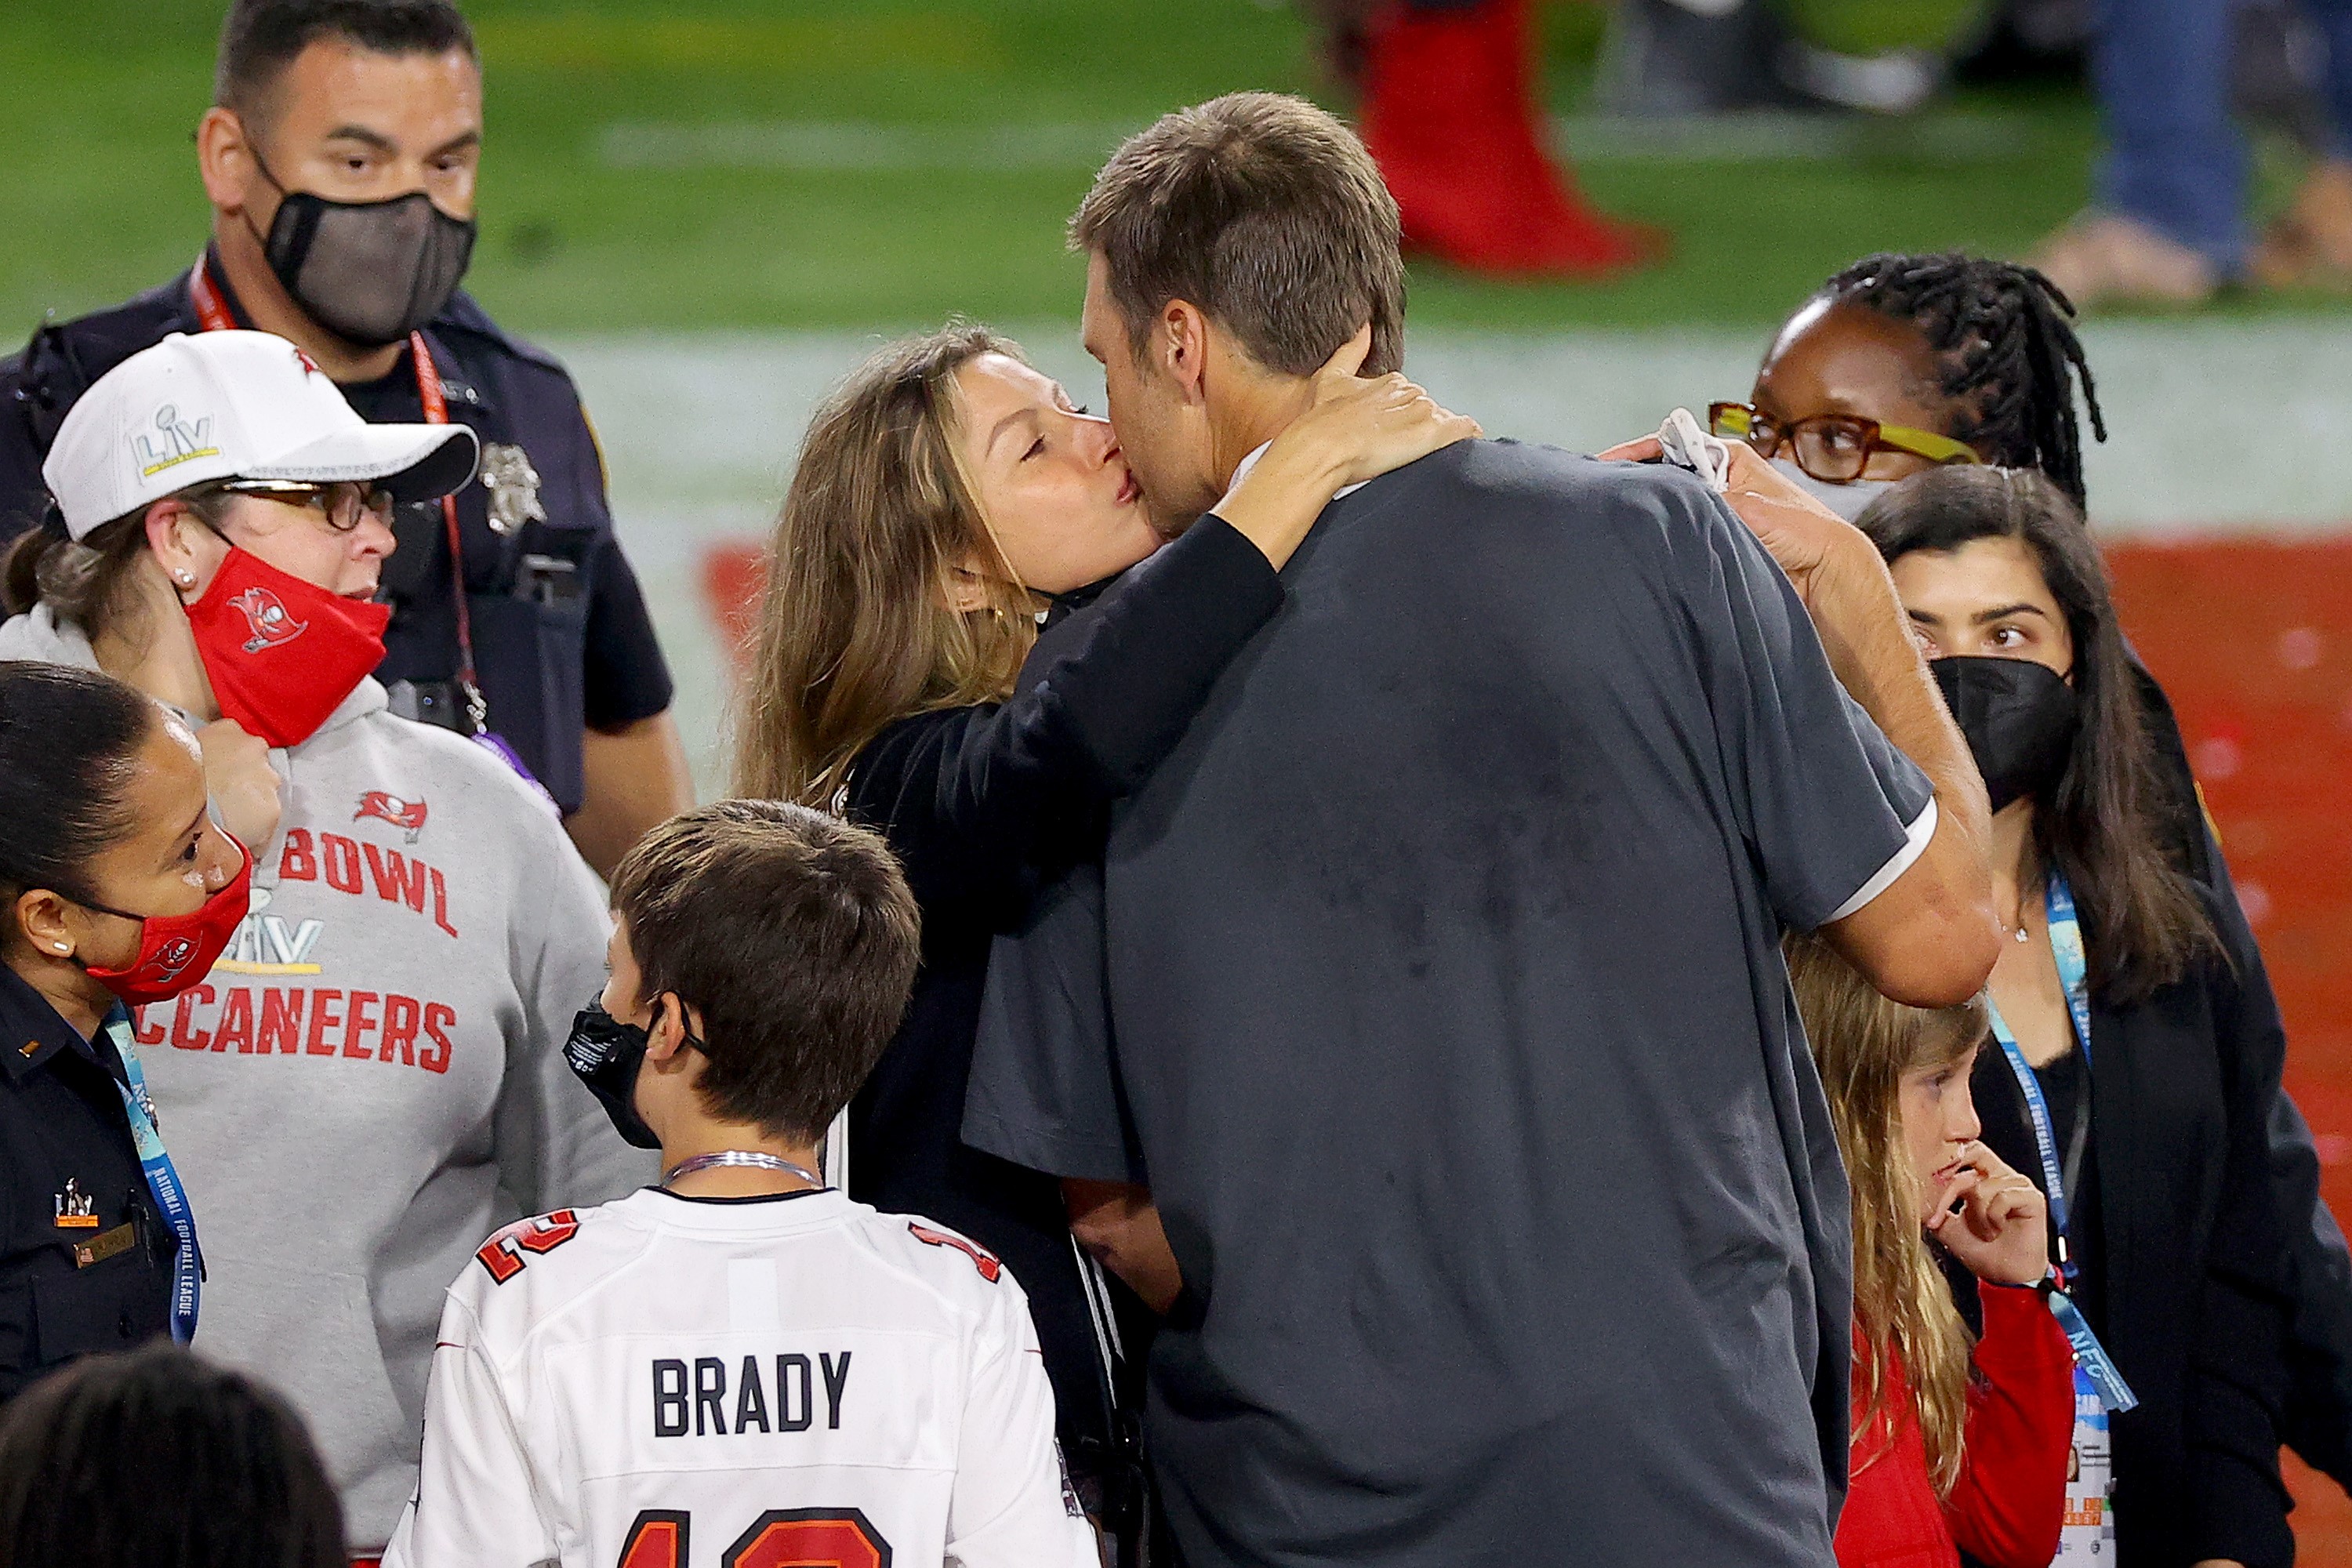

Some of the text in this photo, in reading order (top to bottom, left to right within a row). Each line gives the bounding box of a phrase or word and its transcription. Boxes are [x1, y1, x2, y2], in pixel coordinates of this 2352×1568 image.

[136, 406, 210, 469] LIV
[280, 828, 458, 938] BOWL
[222, 903, 324, 964] IV
[134, 982, 456, 1074] CCANEERS
[153, 1167, 194, 1316] NATIONAL FOOTBALL LEAGUE
[652, 1351, 851, 1437] BRADY
